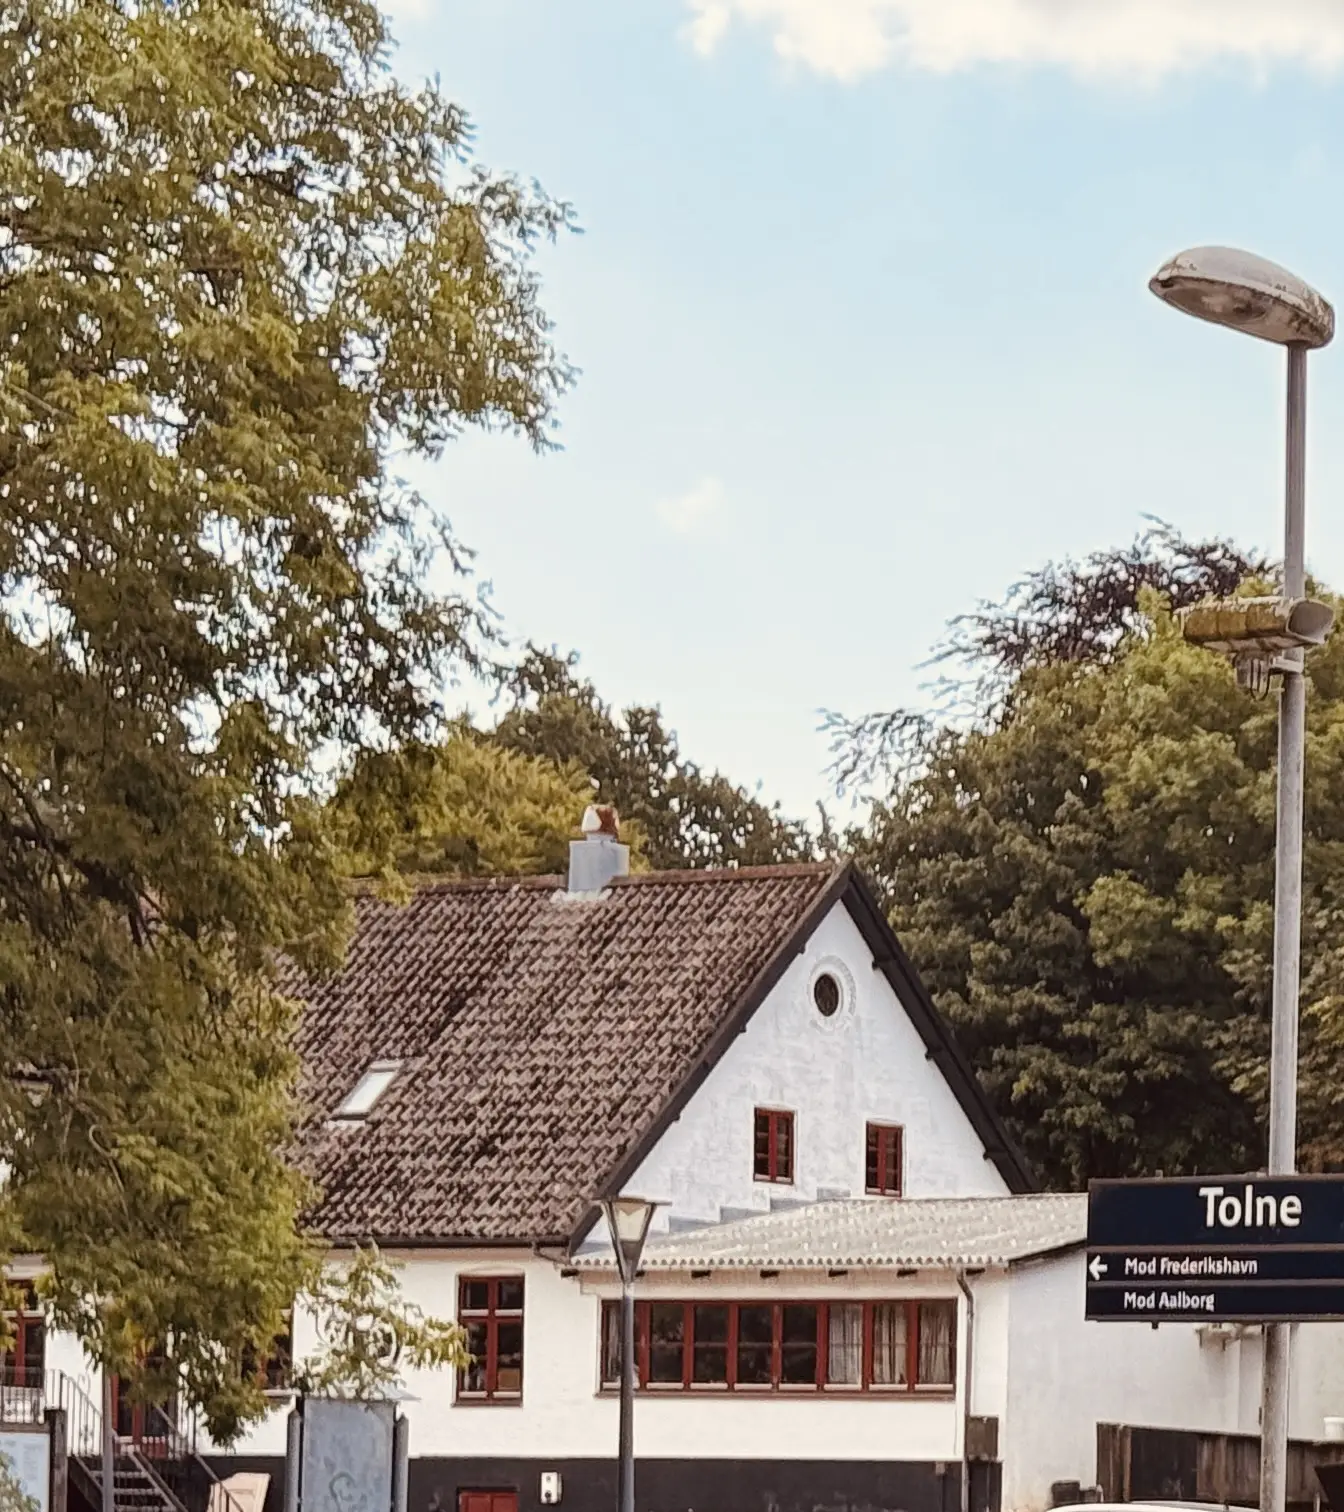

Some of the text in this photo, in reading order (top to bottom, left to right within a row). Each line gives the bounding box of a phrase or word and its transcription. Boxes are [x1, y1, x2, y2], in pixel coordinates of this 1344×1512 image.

[1198, 1185, 1302, 1228] Tolne
[1124, 1255, 1258, 1275] Mod Frederikshavn
[1123, 1290, 1215, 1312] Mod Aalborg
